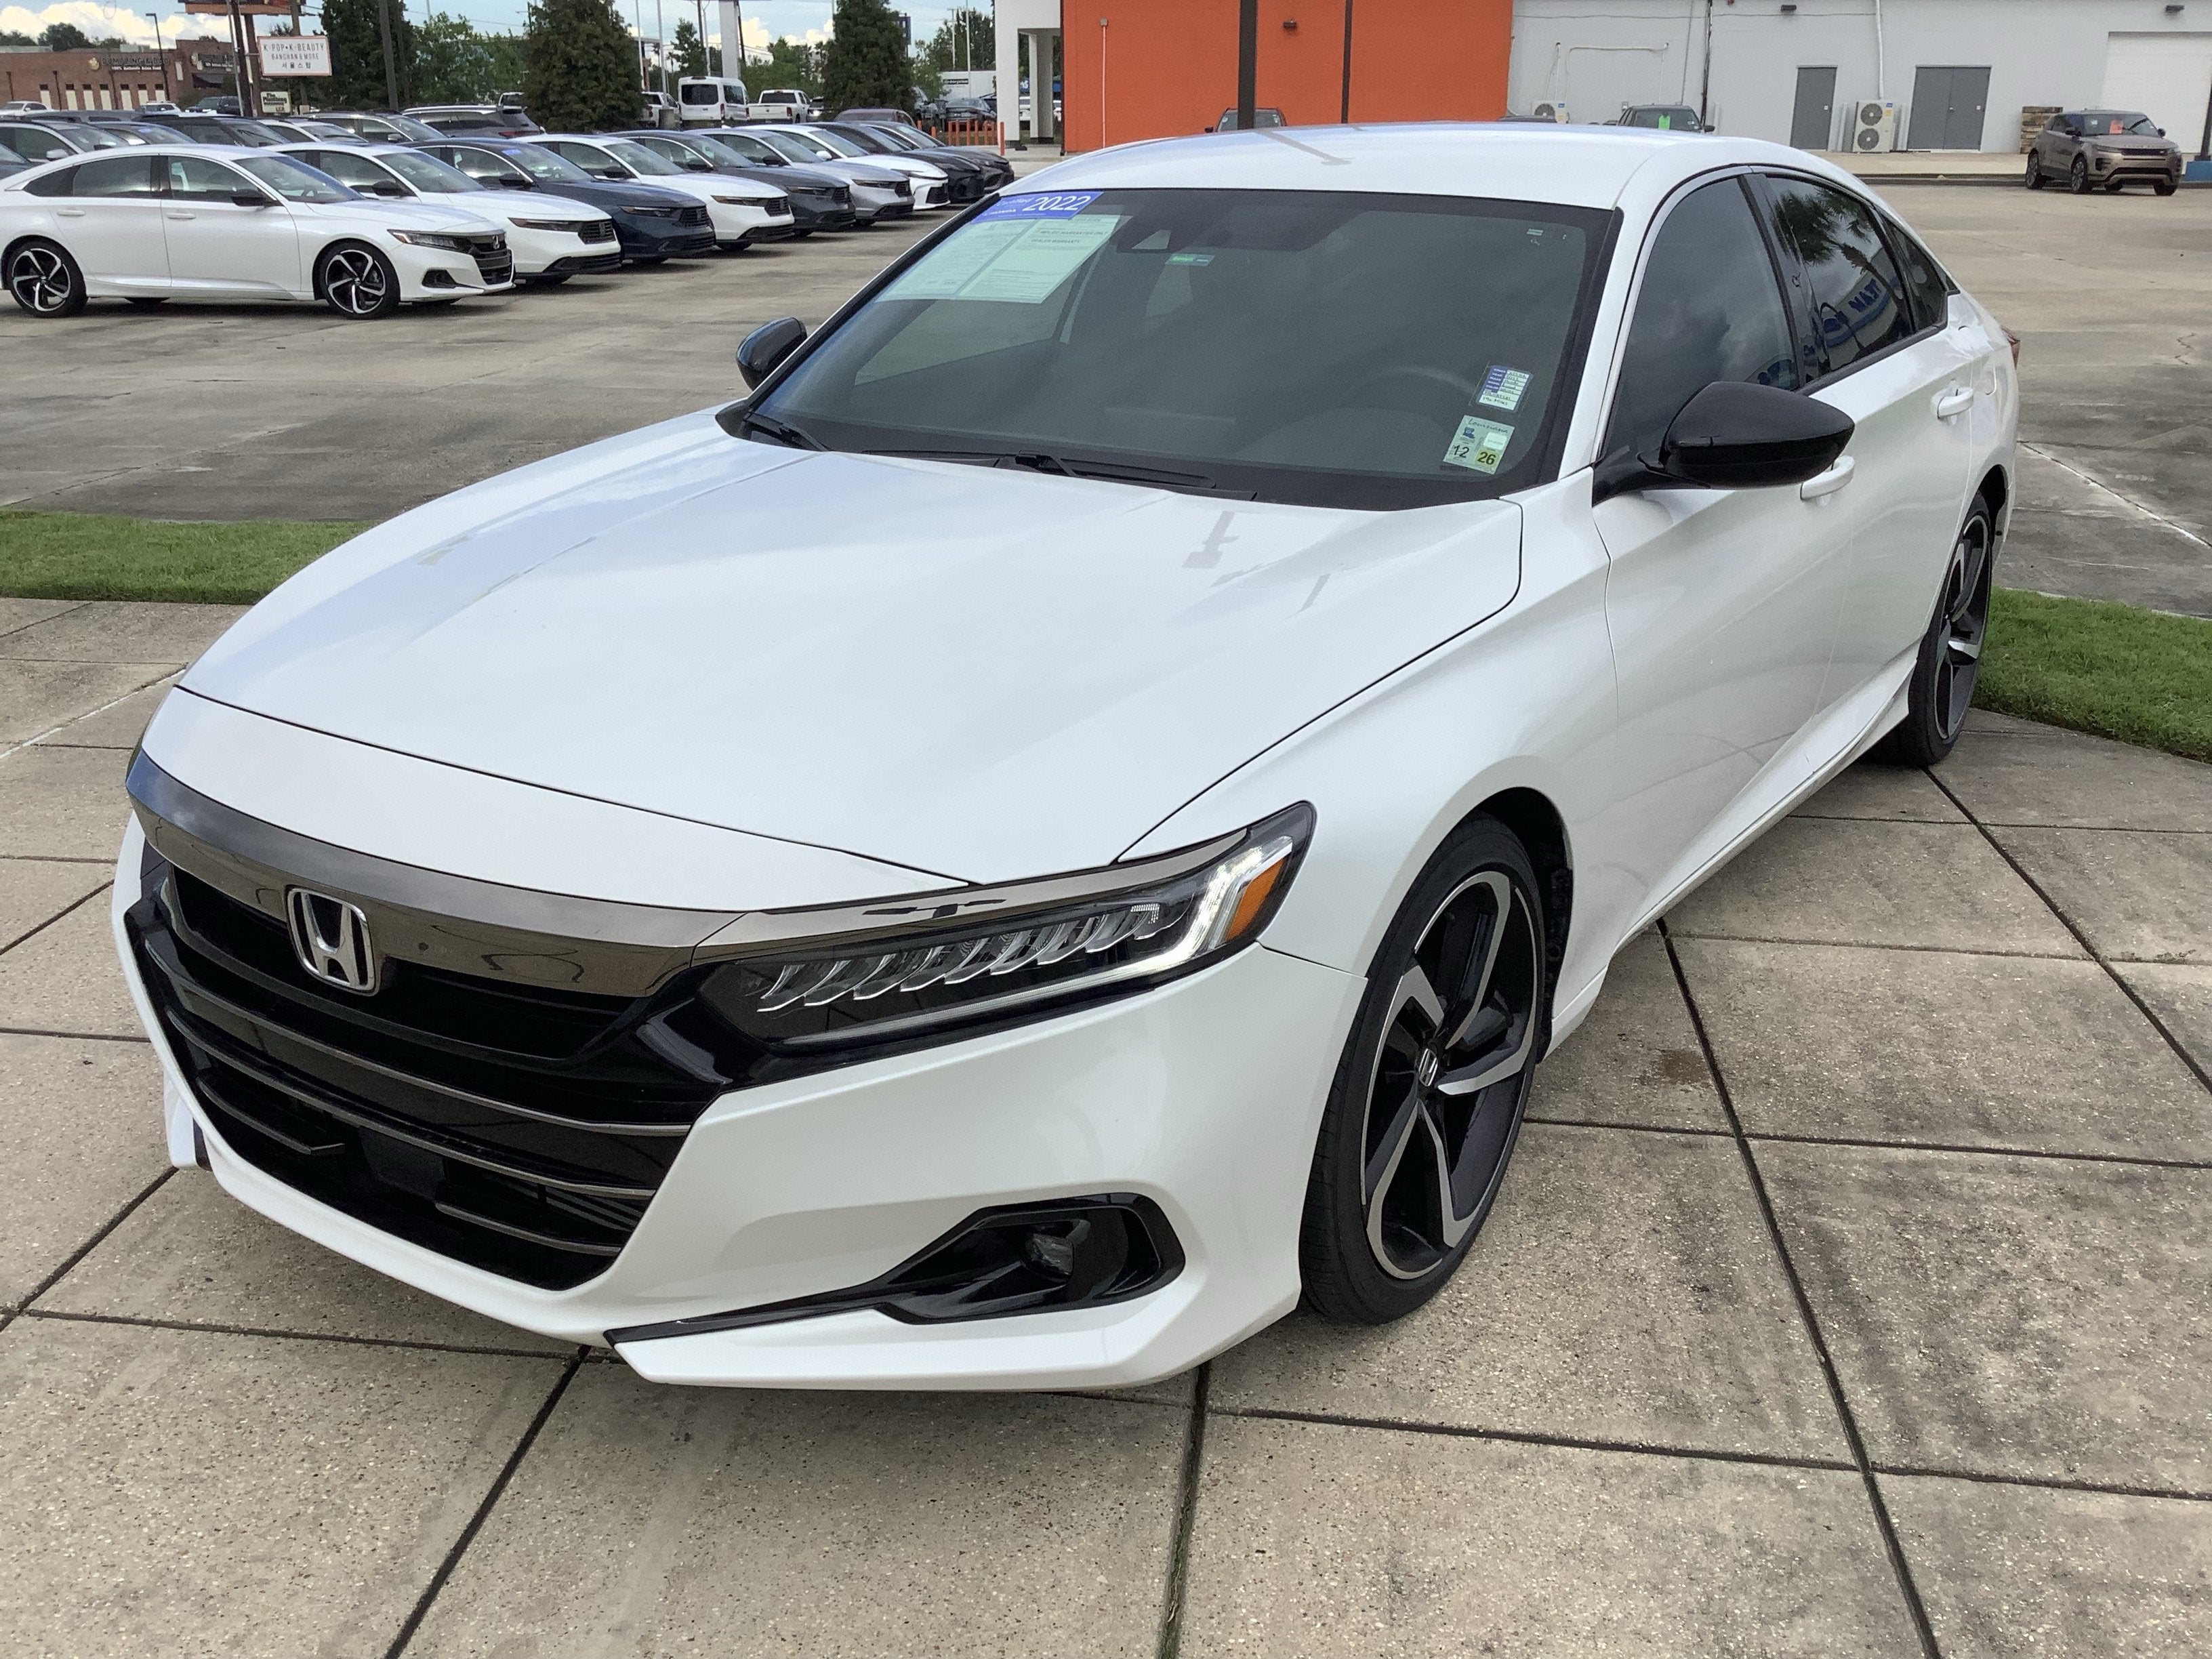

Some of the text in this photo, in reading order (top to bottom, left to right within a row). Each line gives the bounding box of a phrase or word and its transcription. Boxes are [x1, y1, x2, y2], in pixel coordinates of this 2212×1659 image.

[1022, 195, 1091, 211] 2022
[1454, 445, 1496, 466] 12 26
